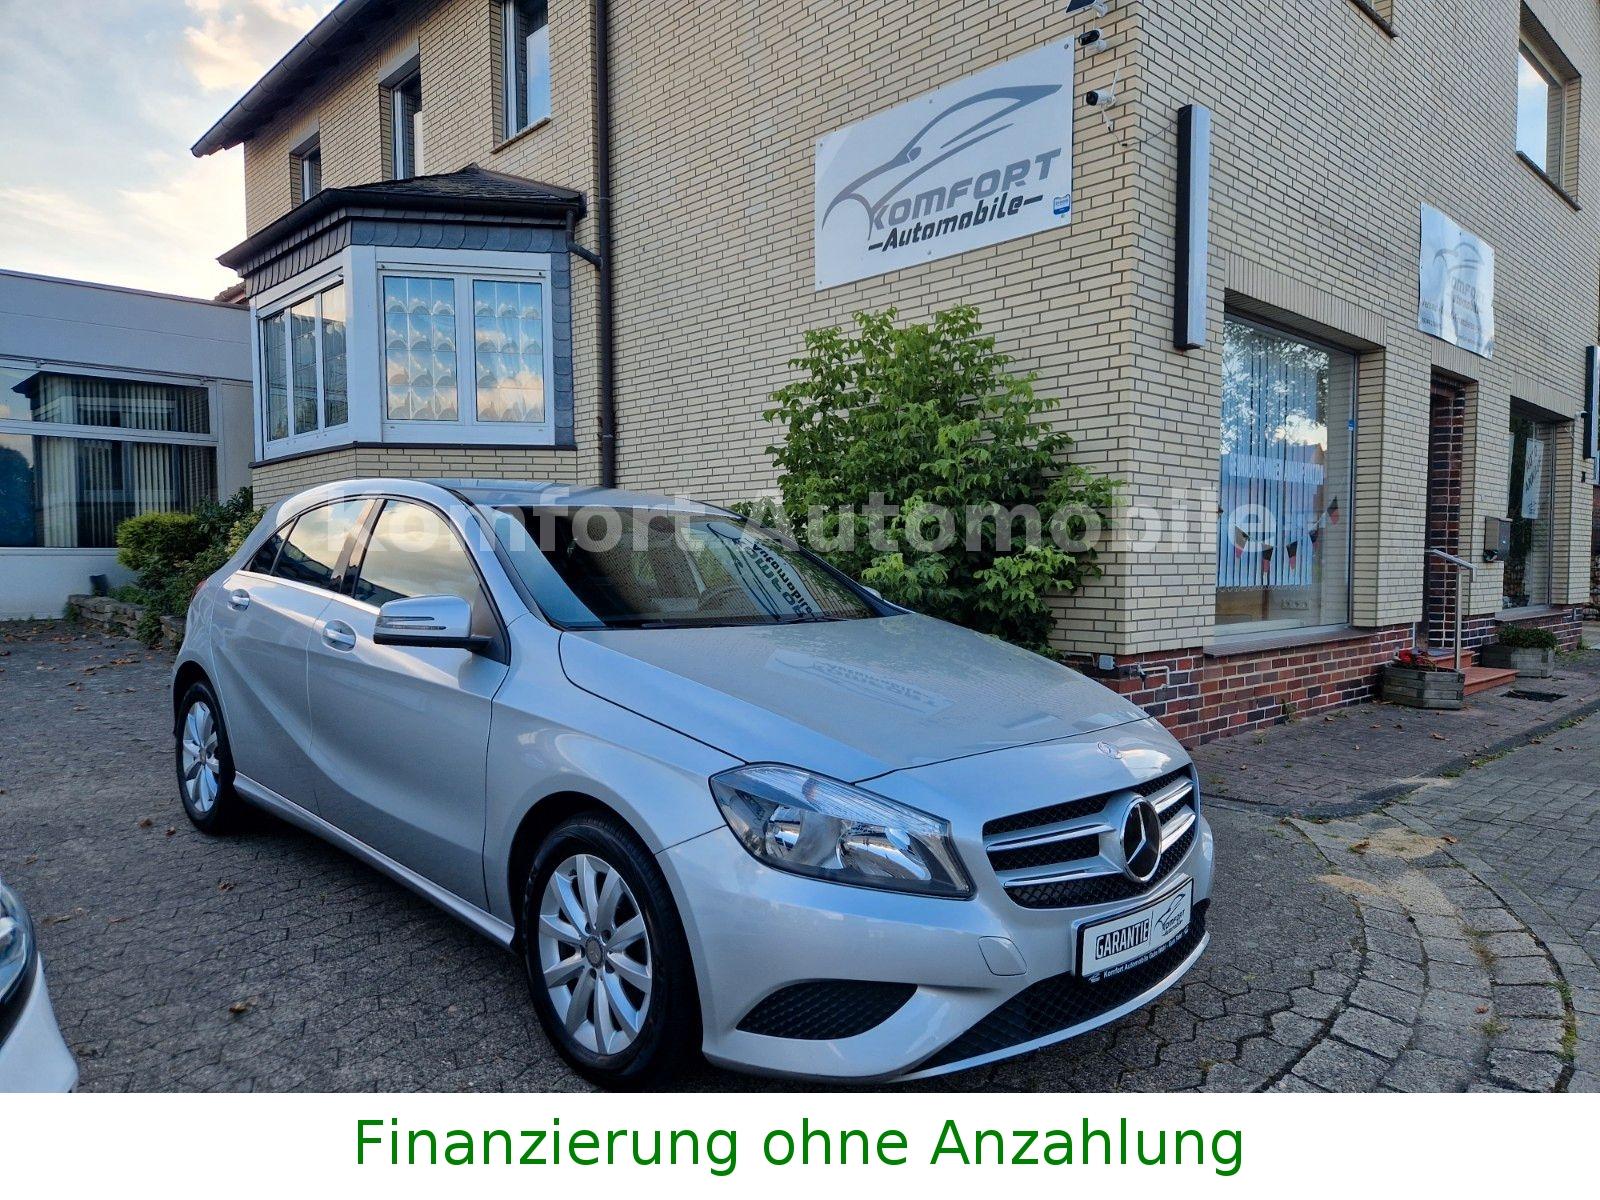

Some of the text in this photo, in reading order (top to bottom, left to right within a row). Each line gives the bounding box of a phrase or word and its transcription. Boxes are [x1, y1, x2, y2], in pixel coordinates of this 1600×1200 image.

[869, 147, 1061, 231] KOMFORT
[1096, 919, 1149, 960] GARANTIE
[1103, 964, 1124, 979] Komfort
[1124, 954, 1149, 972] Automobile
